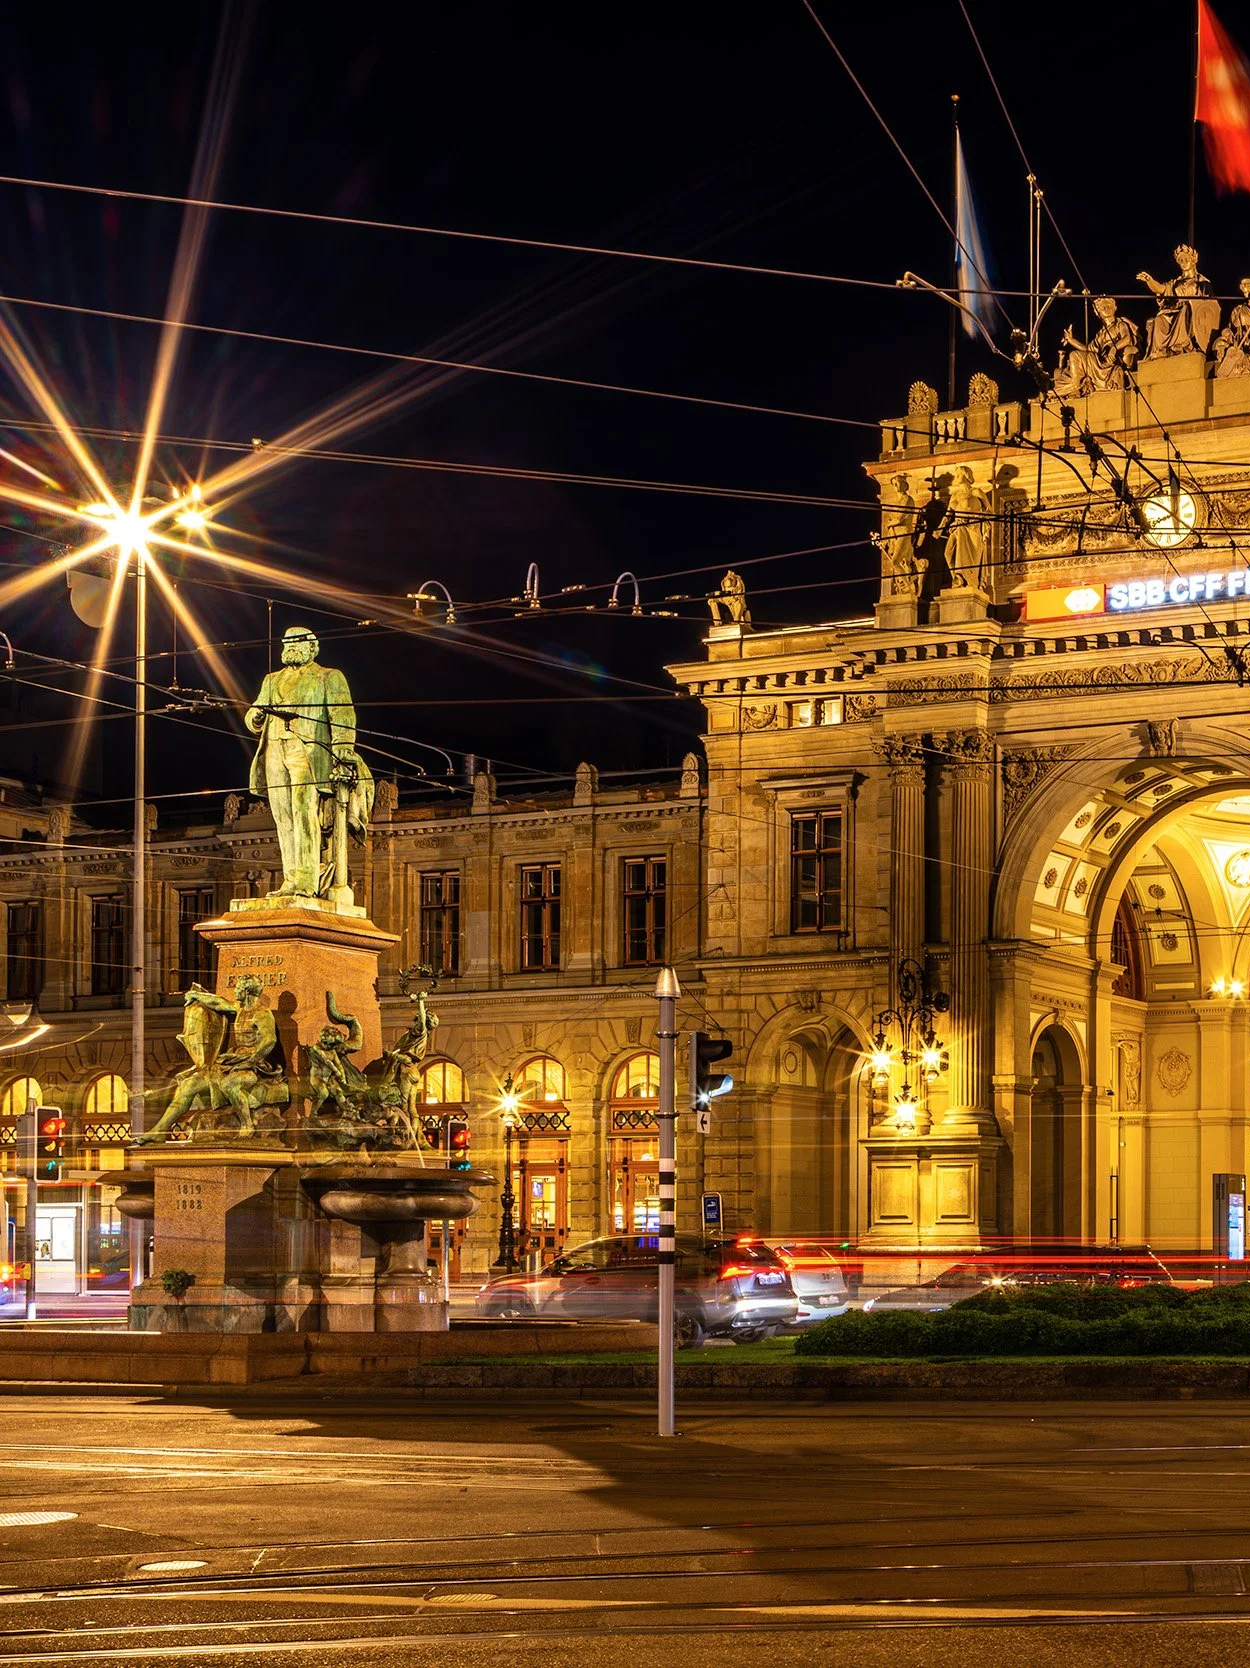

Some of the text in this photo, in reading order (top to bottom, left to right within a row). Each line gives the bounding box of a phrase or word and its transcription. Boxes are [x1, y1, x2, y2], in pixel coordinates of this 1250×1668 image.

[1110, 579, 1165, 610] SBB
[1169, 573, 1224, 603] CFF
[232, 954, 284, 968] ALFRED
[177, 1184, 202, 1195] 1819
[176, 1199, 203, 1210] 1882
